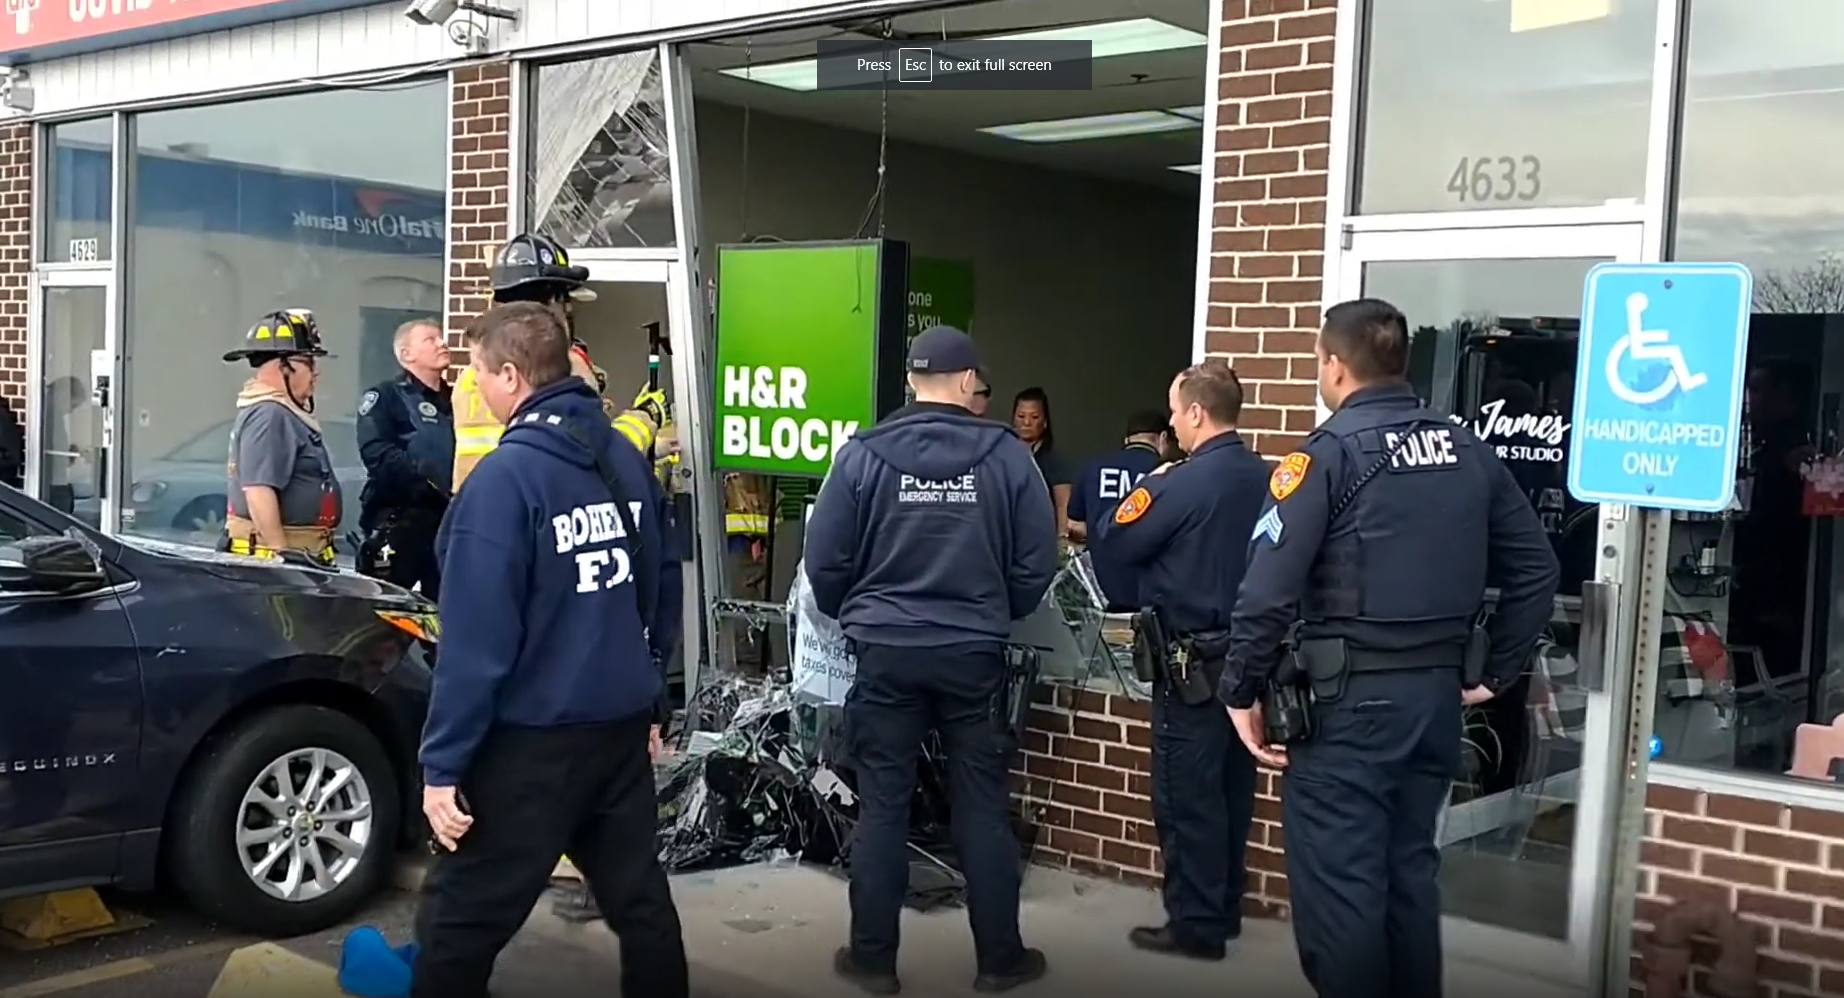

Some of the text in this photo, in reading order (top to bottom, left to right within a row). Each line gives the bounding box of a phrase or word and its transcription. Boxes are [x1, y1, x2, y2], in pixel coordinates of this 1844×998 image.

[1446, 154, 1541, 202] 4633
[71, 239, 96, 262] 4629
[723, 365, 807, 409] H&R
[1474, 399, 1571, 445] James
[1584, 417, 1725, 447] HANDICAPPED
[723, 415, 859, 464] BLOCK
[1385, 429, 1458, 468] POLICE
[1510, 447, 1563, 462] STUDIO
[1622, 451, 1679, 477] ONLY
[898, 490, 978, 502] EMERGENCY SERVICE
[901, 474, 975, 490] POLICE
[801, 655, 827, 675] taxes
